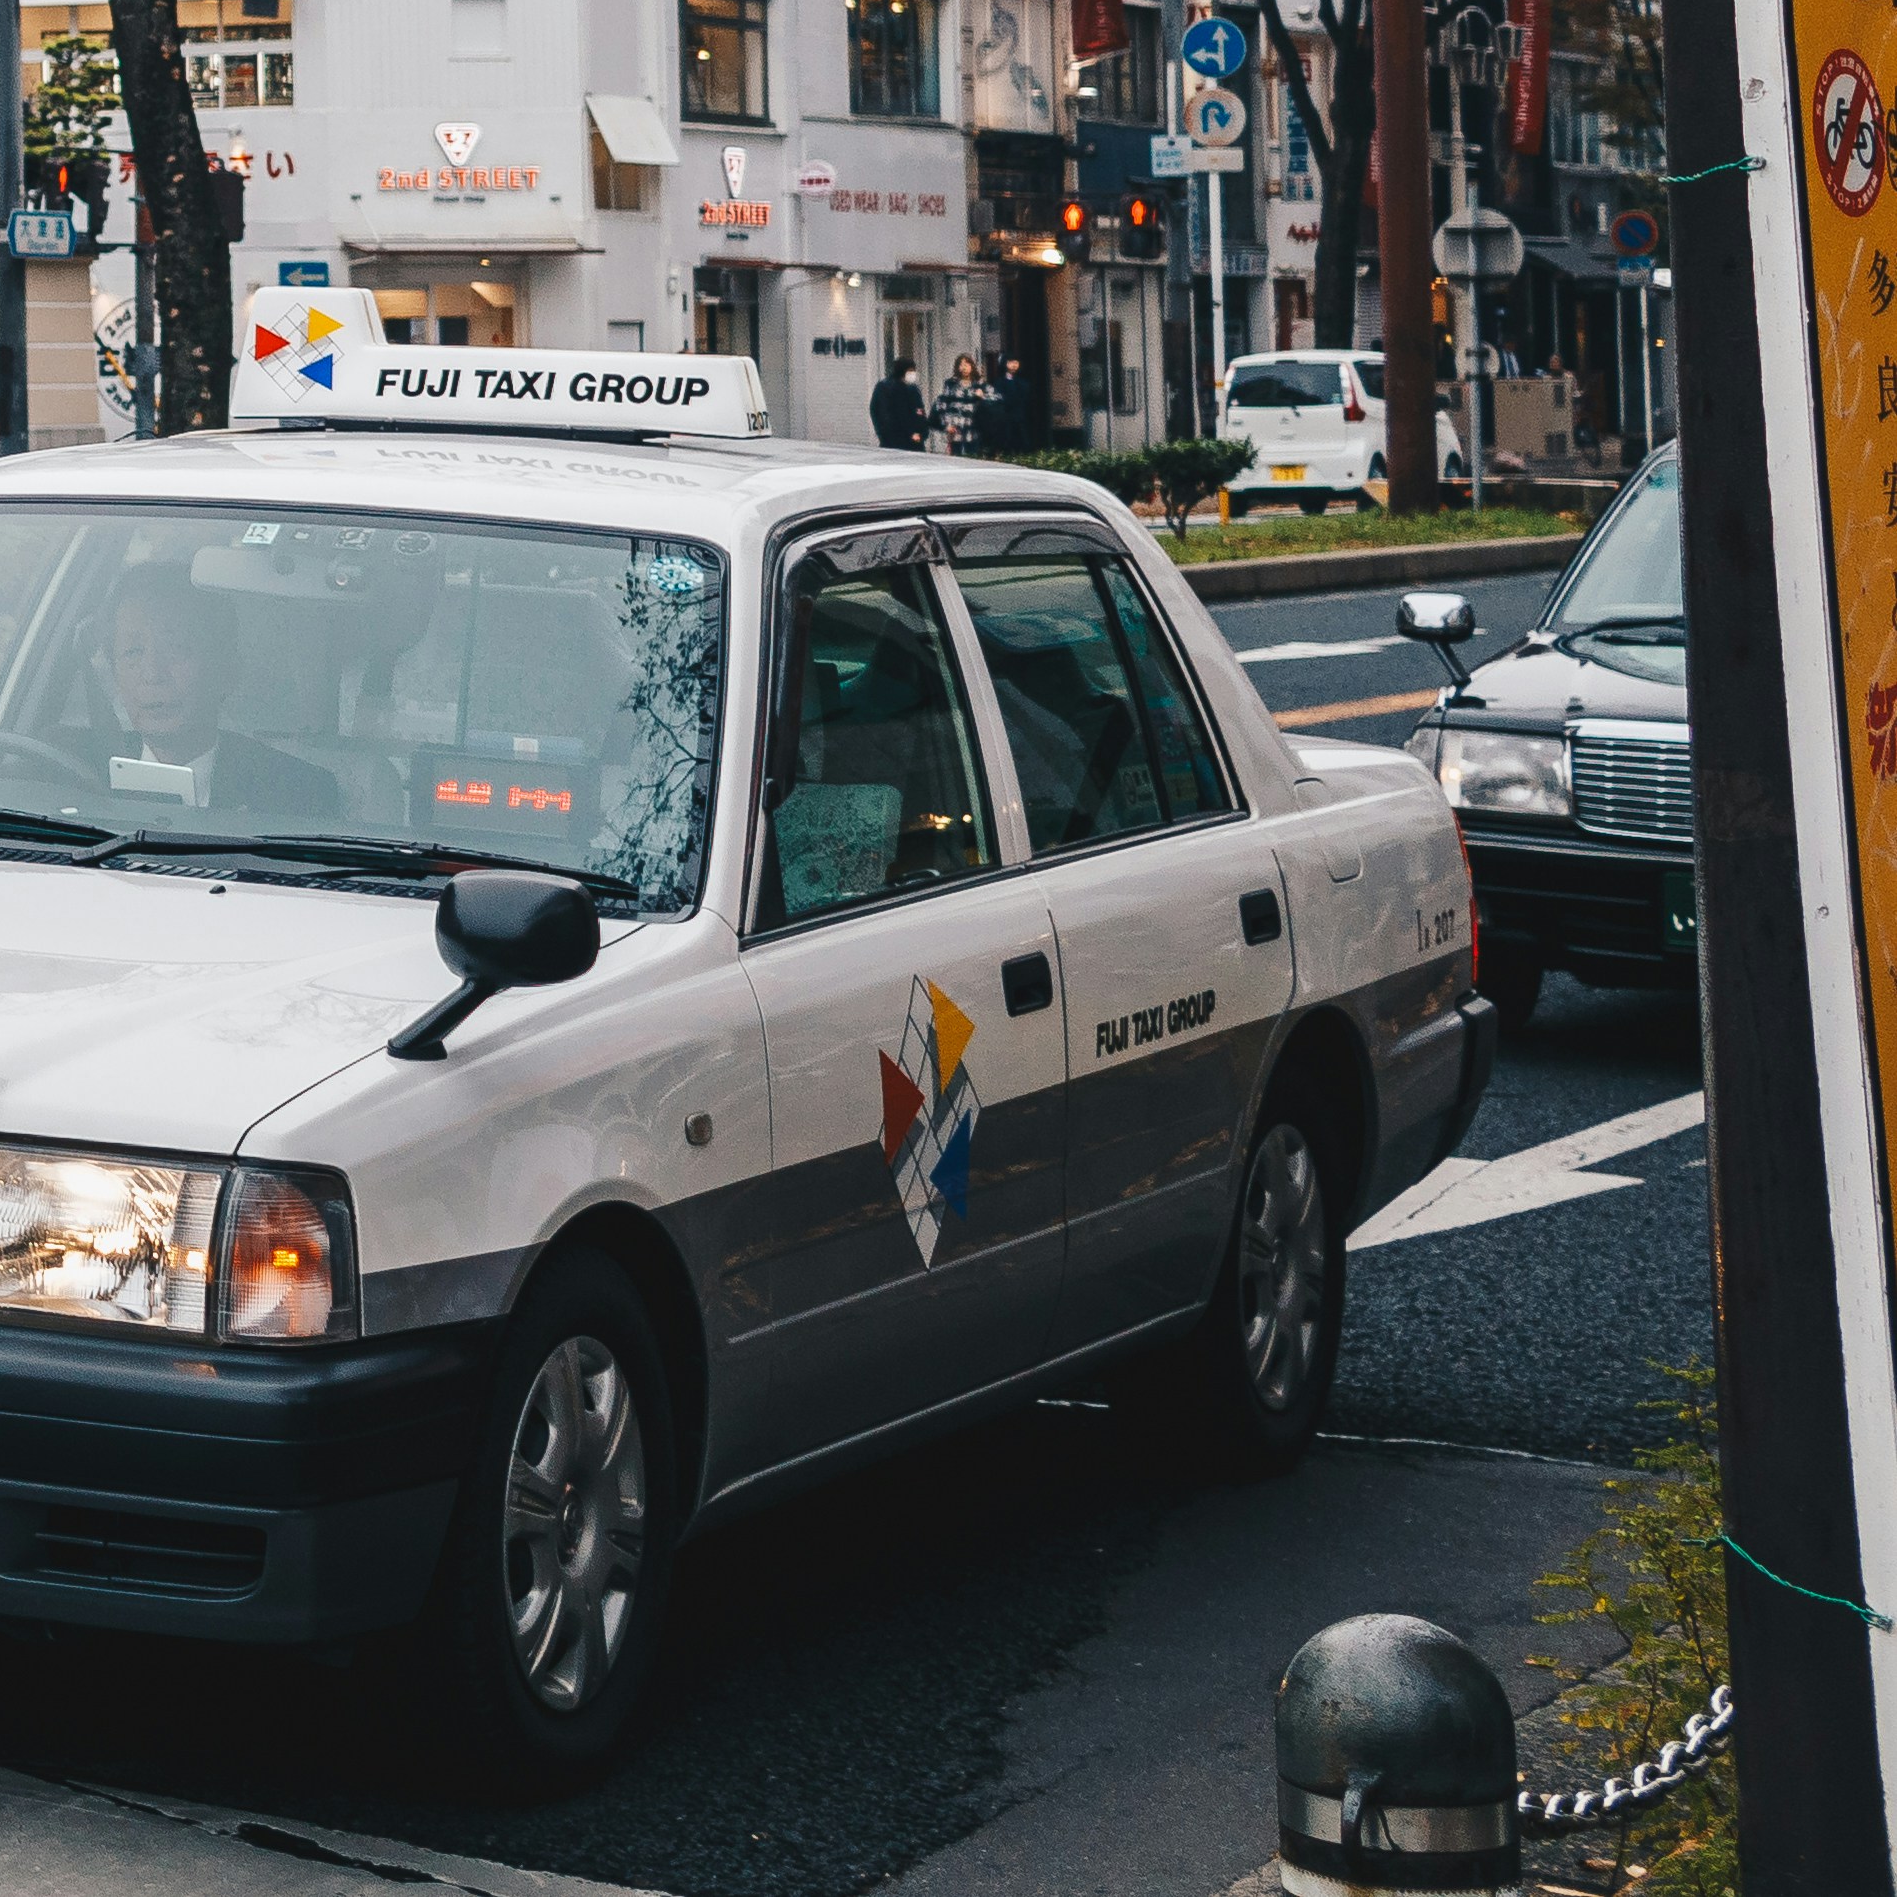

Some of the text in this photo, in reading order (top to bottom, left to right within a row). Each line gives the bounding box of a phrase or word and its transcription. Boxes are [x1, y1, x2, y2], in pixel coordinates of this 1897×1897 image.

[379, 166, 541, 190] 2nd STREET
[702, 200, 771, 226] 2nd STREET
[376, 369, 710, 406] FUJI TAXI GROUP
[1096, 989, 1217, 1057] FUJI TAXI GROUP
